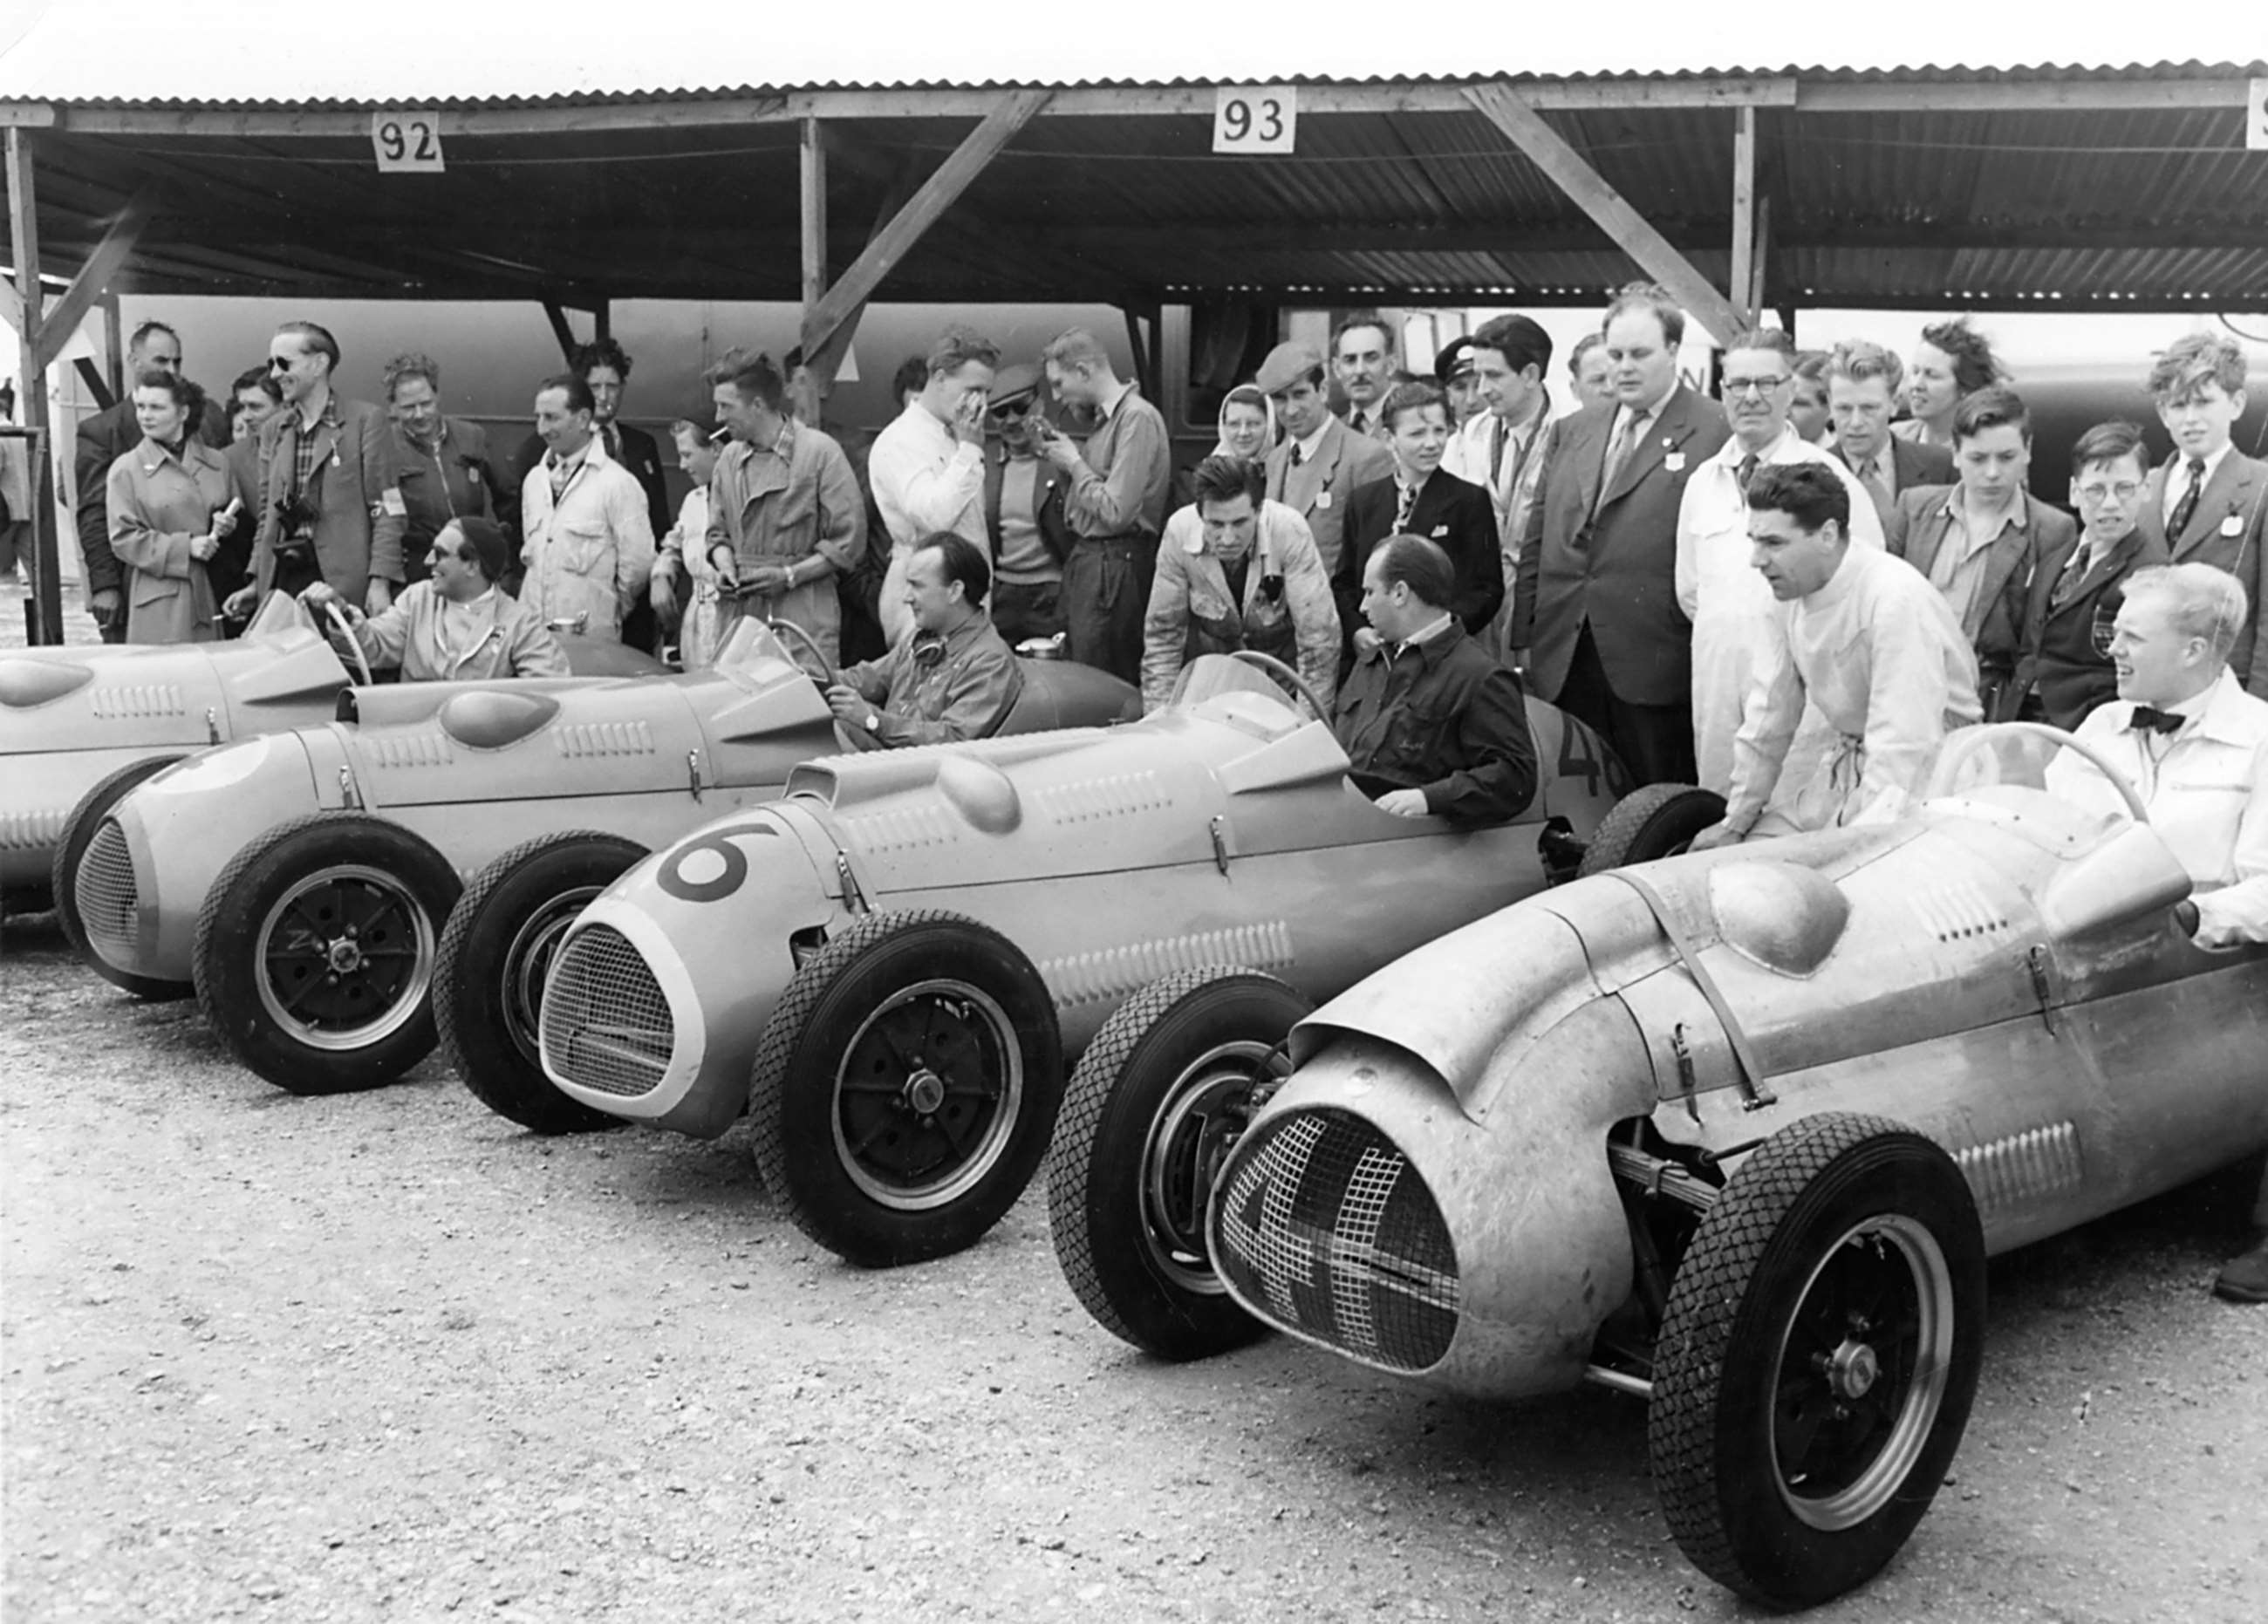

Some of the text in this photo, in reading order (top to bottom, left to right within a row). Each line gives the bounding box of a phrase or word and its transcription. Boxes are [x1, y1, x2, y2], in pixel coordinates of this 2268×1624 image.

[380, 122, 437, 160] 92
[1225, 98, 1283, 141] 93
[1222, 1115, 1405, 1348] 41
